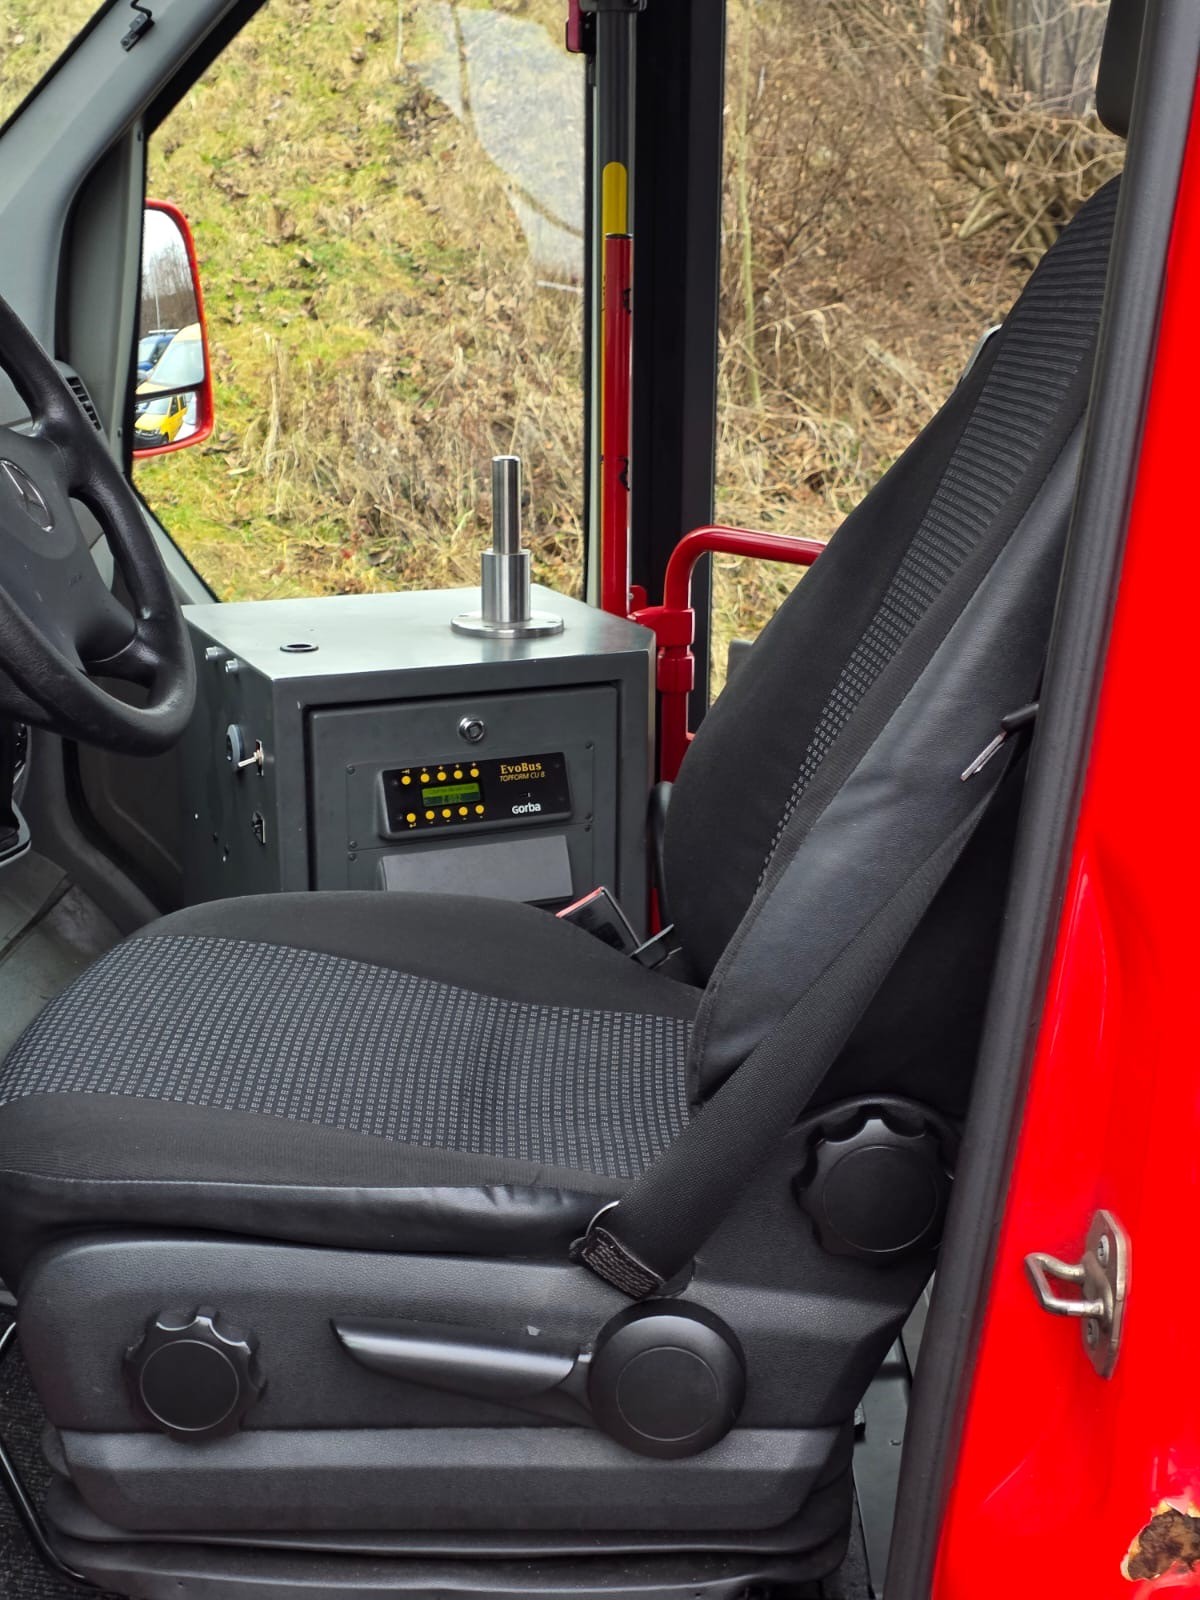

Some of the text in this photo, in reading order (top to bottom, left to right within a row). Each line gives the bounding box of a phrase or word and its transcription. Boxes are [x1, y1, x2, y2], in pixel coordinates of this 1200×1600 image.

[500, 762, 542, 774] EvoBus
[499, 773, 529, 782] TOPFORM
[512, 802, 541, 814] Gorba
